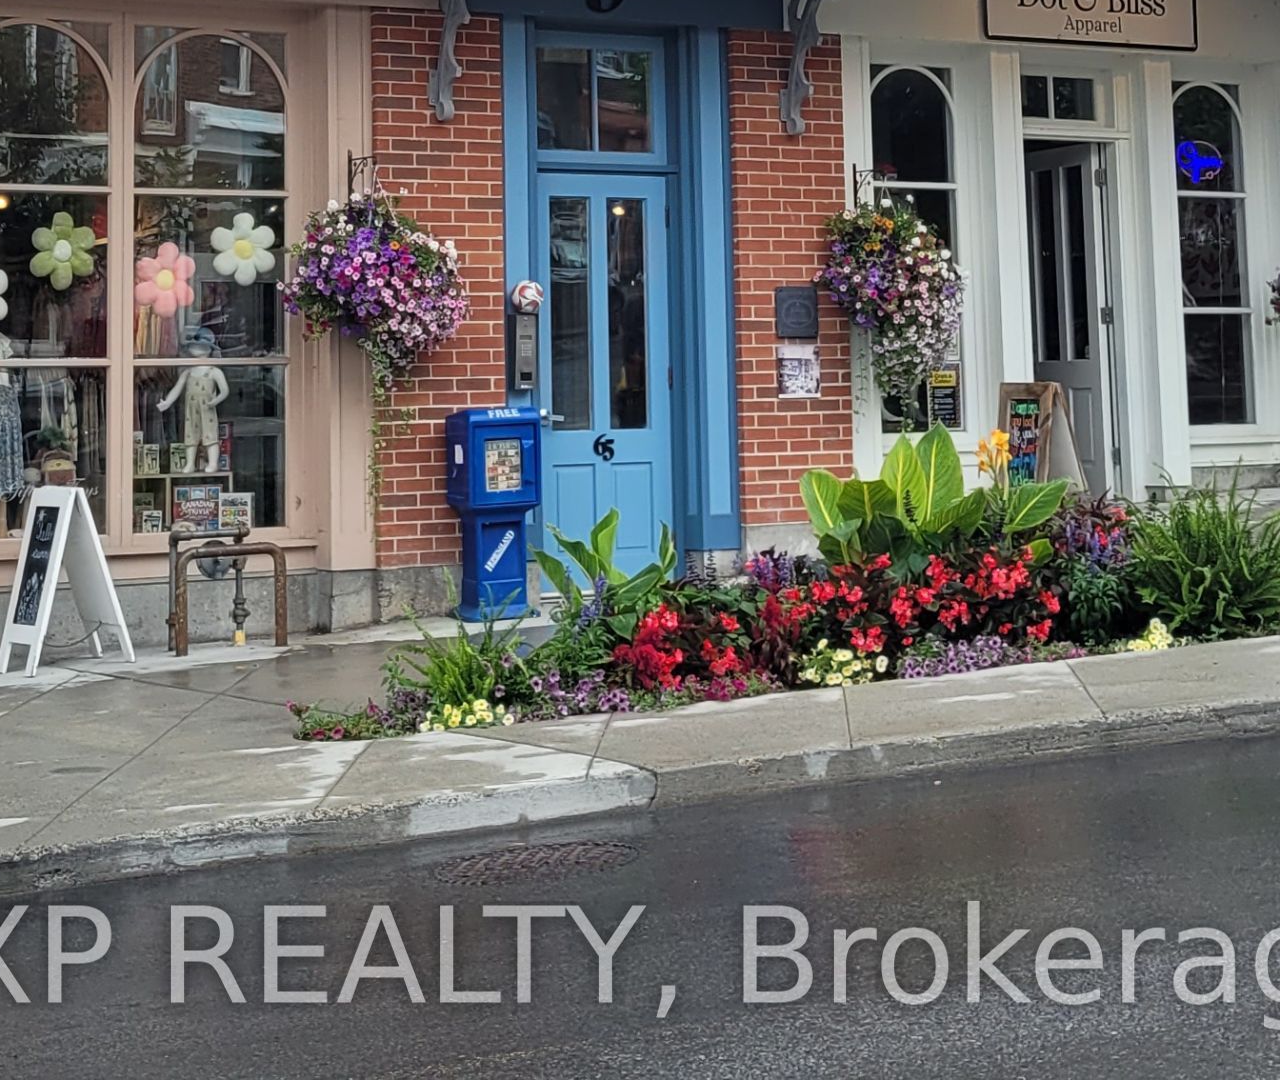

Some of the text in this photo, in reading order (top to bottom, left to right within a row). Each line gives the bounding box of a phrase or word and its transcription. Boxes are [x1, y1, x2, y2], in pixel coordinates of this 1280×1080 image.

[1064, 15, 1122, 34] Apparel
[487, 408, 520, 419] FREE
[593, 434, 615, 461] 65
